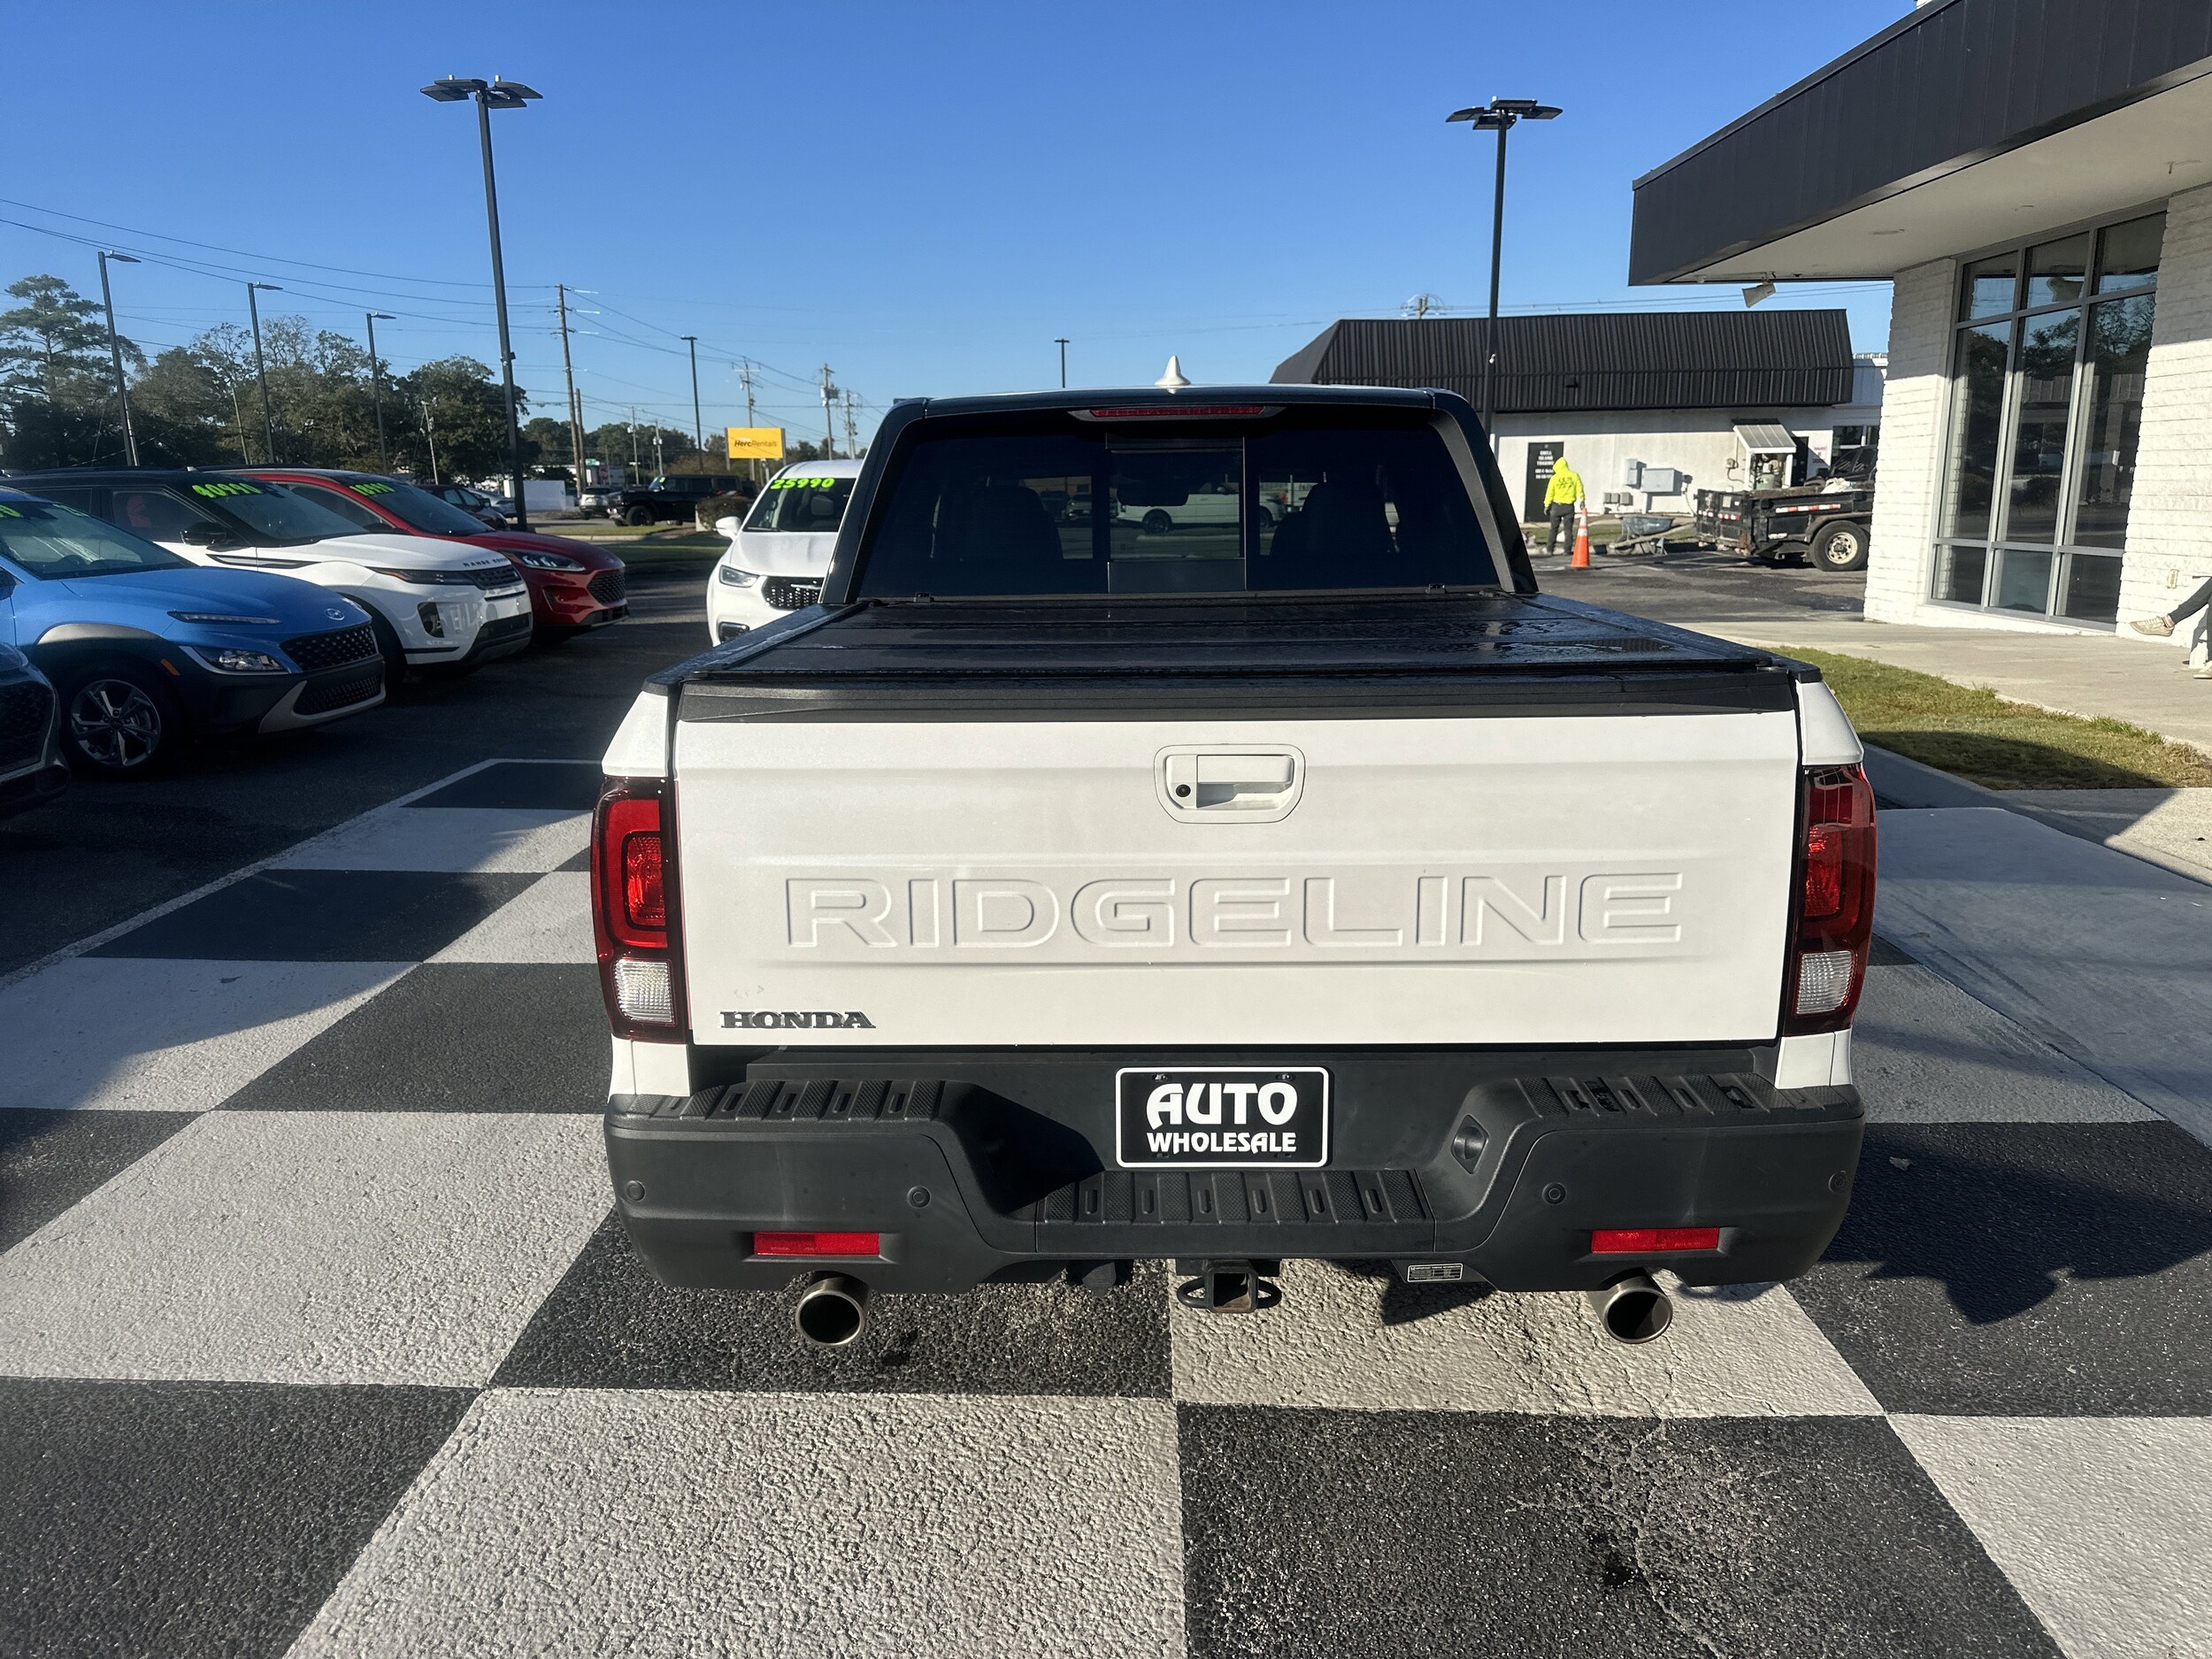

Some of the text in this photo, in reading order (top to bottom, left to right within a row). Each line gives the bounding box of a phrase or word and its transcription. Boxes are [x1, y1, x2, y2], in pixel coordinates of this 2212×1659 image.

[191, 482, 262, 498] 40990
[770, 478, 834, 489] 25990
[786, 872, 1682, 948] RIDGELINE
[719, 1010, 876, 1029] HONDA
[1146, 1082, 1298, 1130] AUTO
[1146, 1132, 1297, 1155] WHOLESALE
